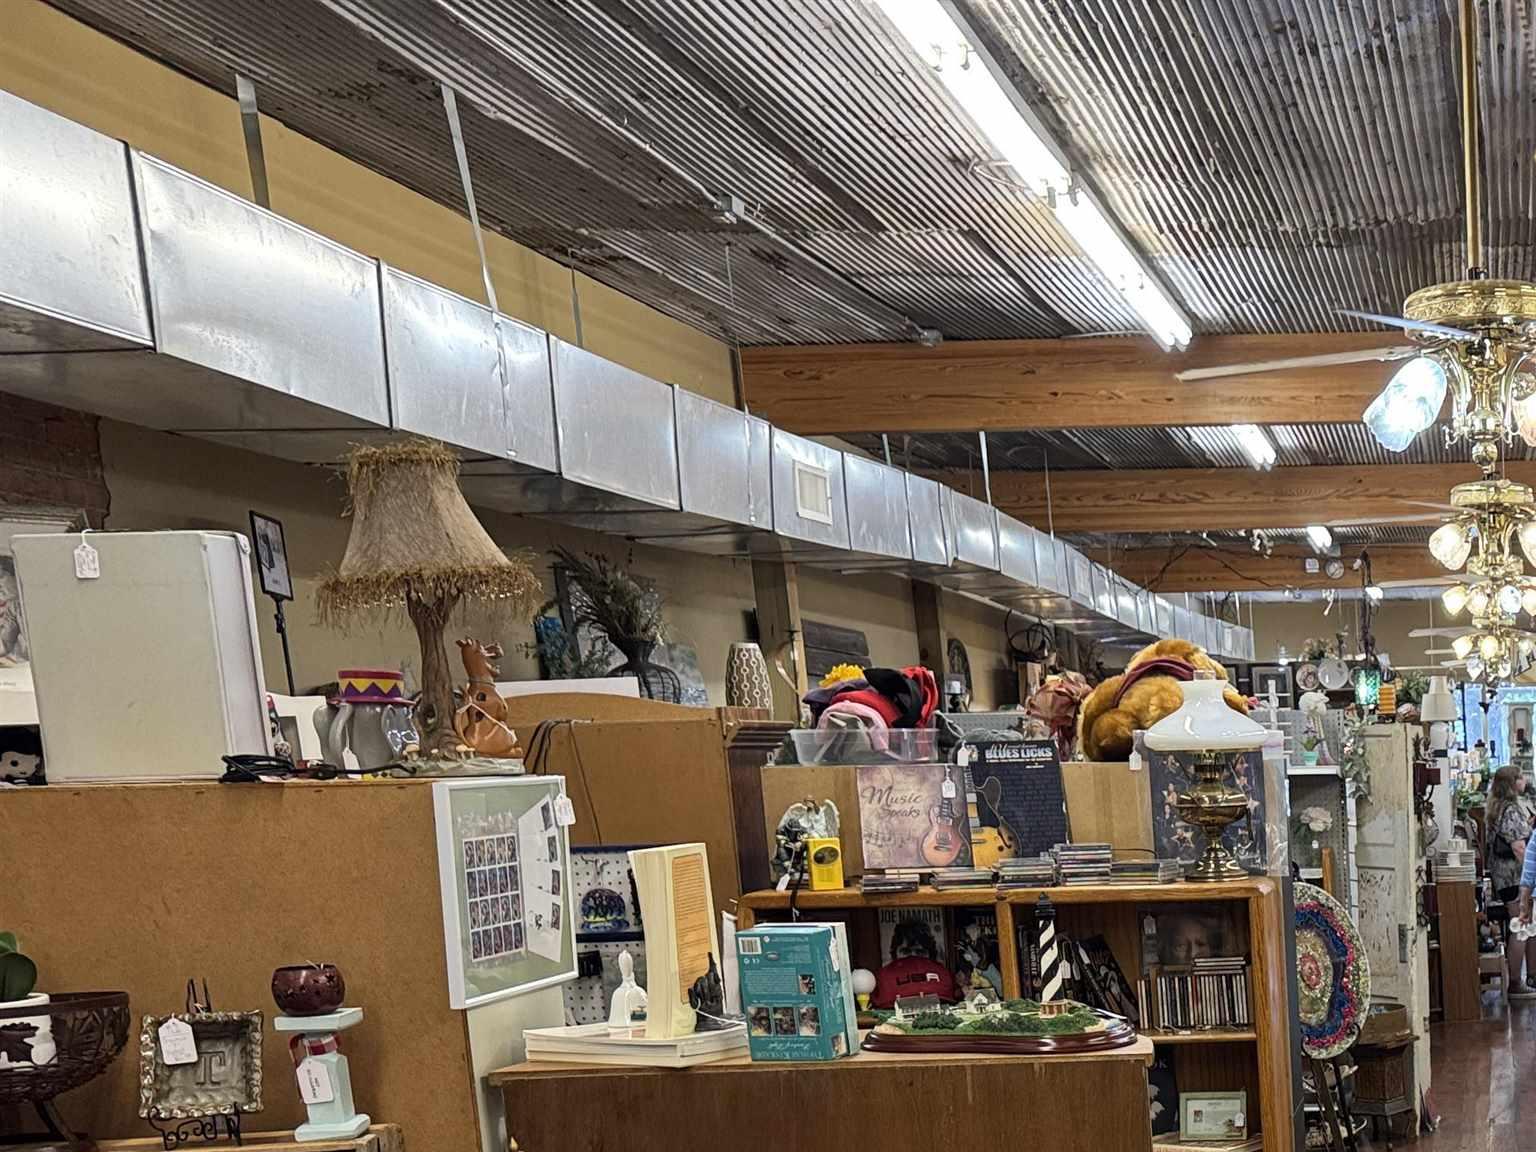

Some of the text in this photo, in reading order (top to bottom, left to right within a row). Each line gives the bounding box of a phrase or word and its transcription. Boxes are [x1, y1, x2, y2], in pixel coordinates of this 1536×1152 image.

[985, 744, 1053, 759] BLUES LICKS
[861, 785, 921, 807] Music
[880, 806, 921, 818] Speaks
[880, 909, 940, 922] JOE NAMATH
